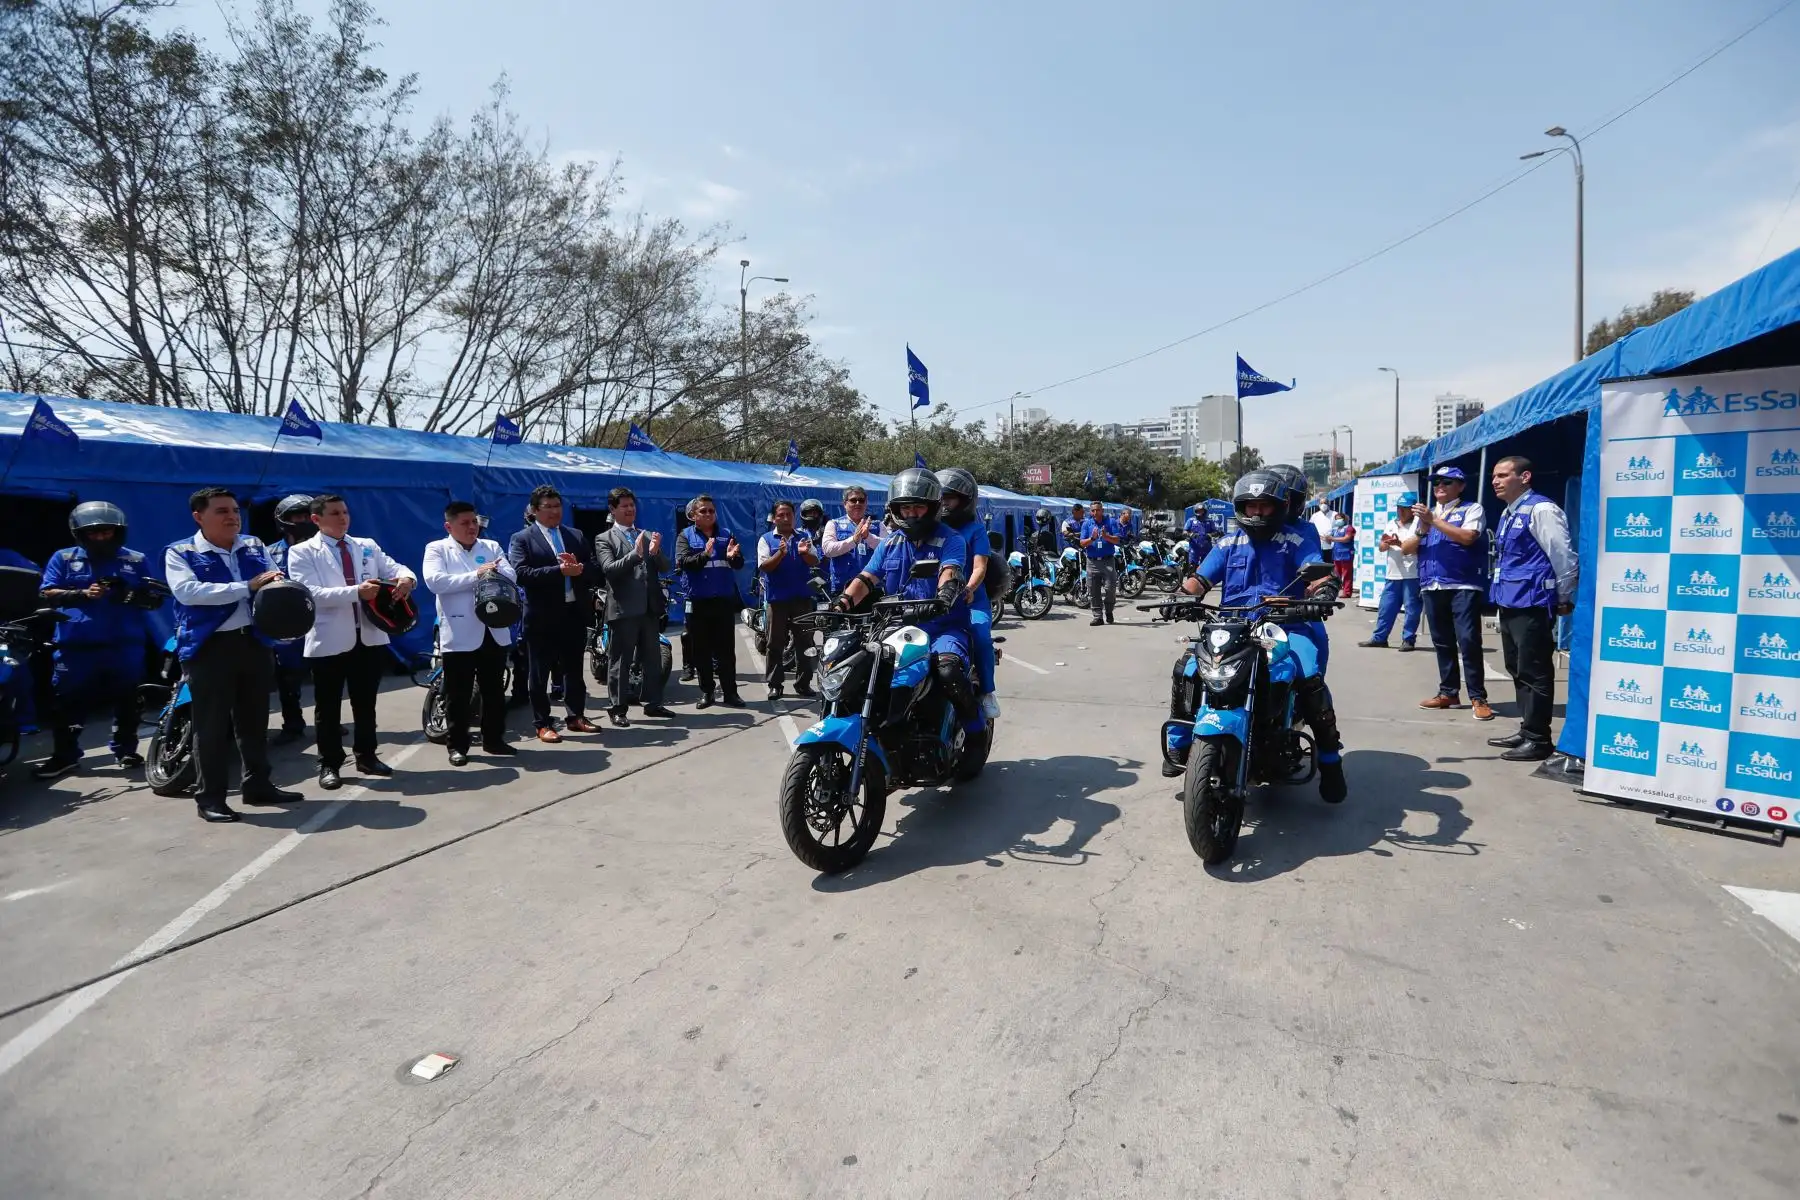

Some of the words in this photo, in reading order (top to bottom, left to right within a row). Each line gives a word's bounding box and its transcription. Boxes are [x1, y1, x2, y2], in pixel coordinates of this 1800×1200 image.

[1724, 387, 1800, 413] EsSa
[1615, 469, 1665, 482] EsSalud
[1682, 467, 1736, 480] EsSalud
[1613, 527, 1663, 538] EsSalud
[1679, 527, 1733, 538] EsSalud
[1611, 582, 1660, 594] EsSalud
[1676, 585, 1730, 597] EsSalud
[1608, 637, 1657, 650] EsSalud
[1673, 642, 1726, 656] EsSalud
[1744, 647, 1800, 661] EsSalud
[1605, 690, 1653, 705] EsSalud
[1669, 698, 1722, 714] EsSalud
[1740, 706, 1797, 722] EsSalud
[1601, 744, 1650, 760] EsSalud
[1666, 754, 1718, 771] EsSalud
[1735, 764, 1793, 782] EsSalud
